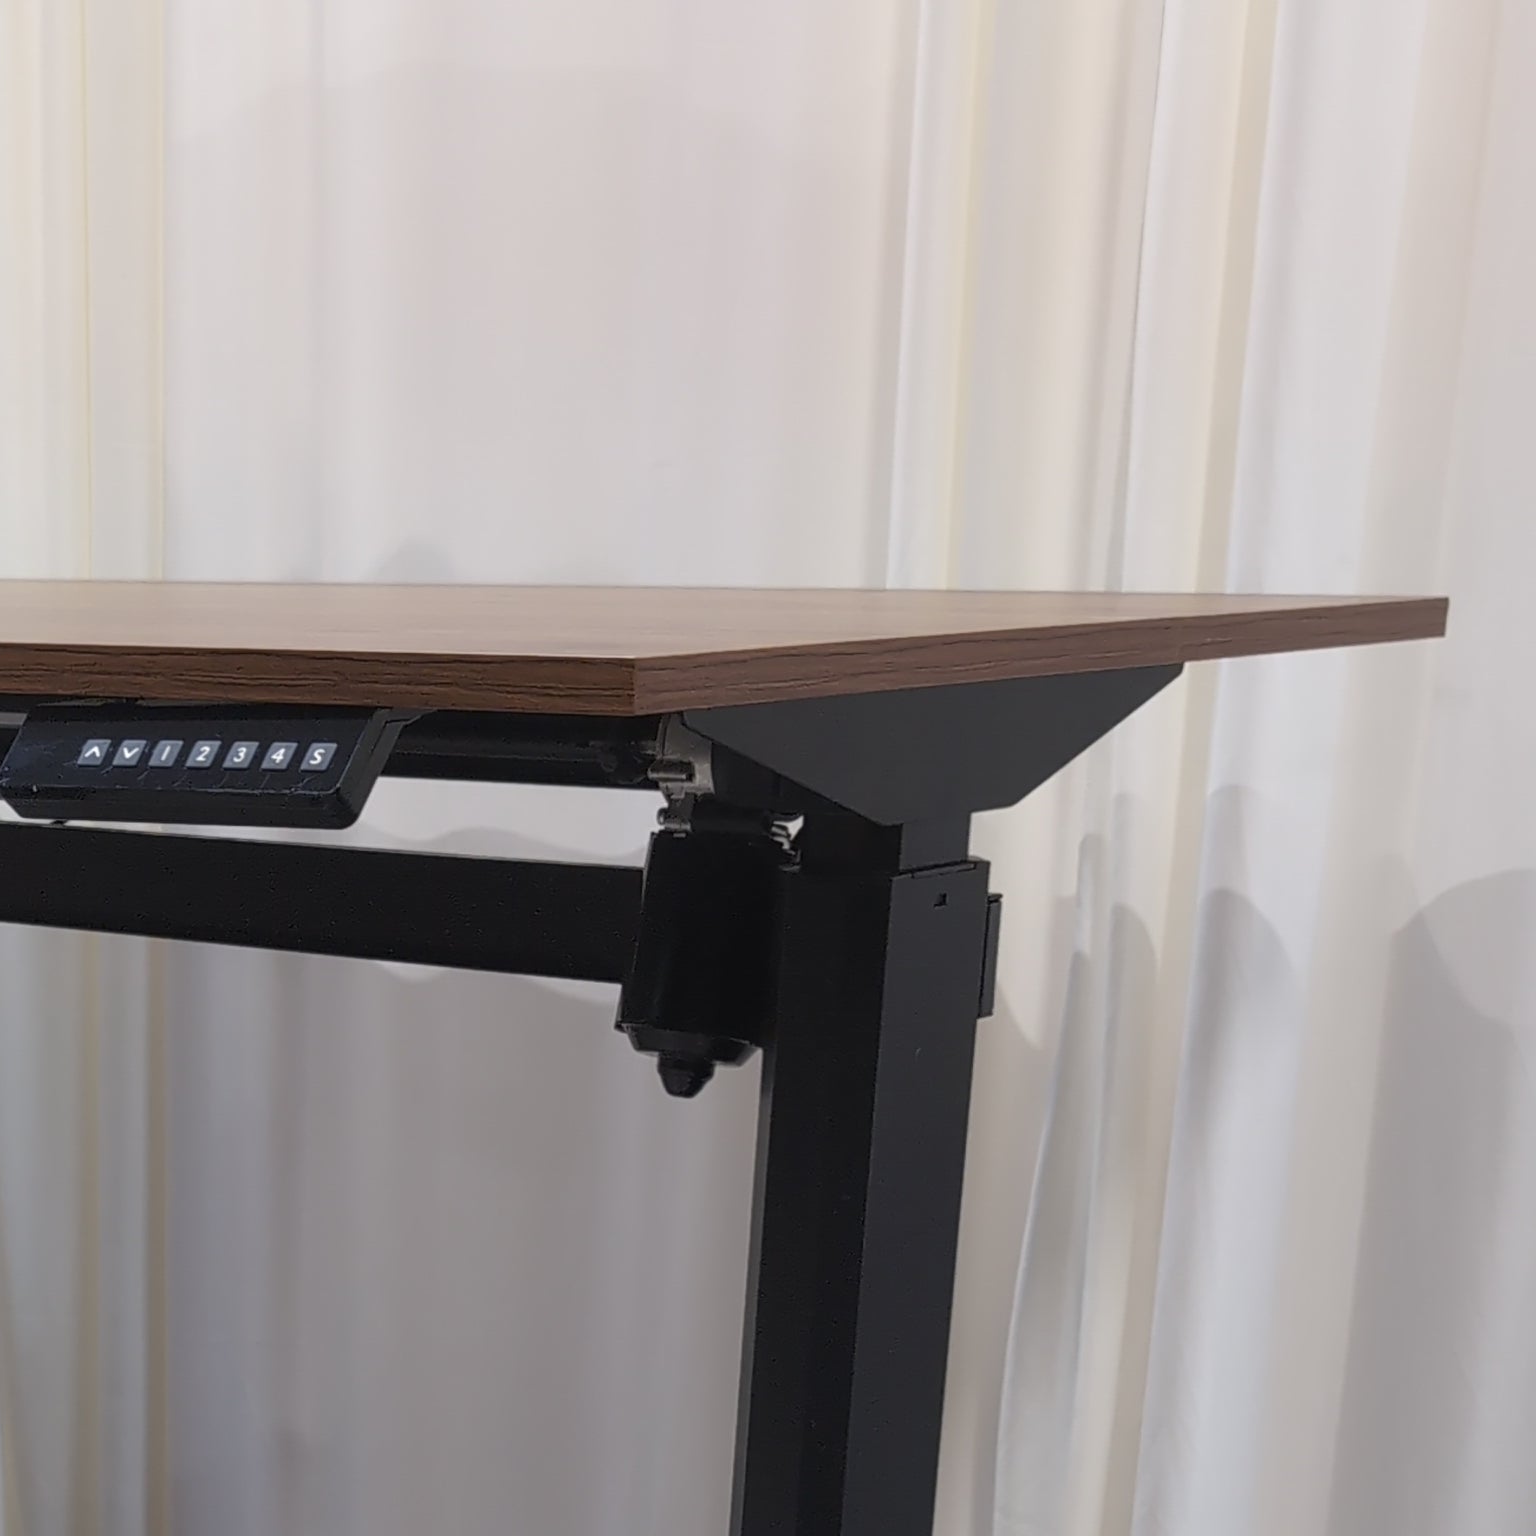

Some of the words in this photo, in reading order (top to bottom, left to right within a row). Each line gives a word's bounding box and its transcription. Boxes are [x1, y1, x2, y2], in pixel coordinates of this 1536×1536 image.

[195, 746, 211, 762] 2
[233, 747, 247, 763] 3
[271, 748, 286, 763] 4
[309, 749, 326, 765] S
